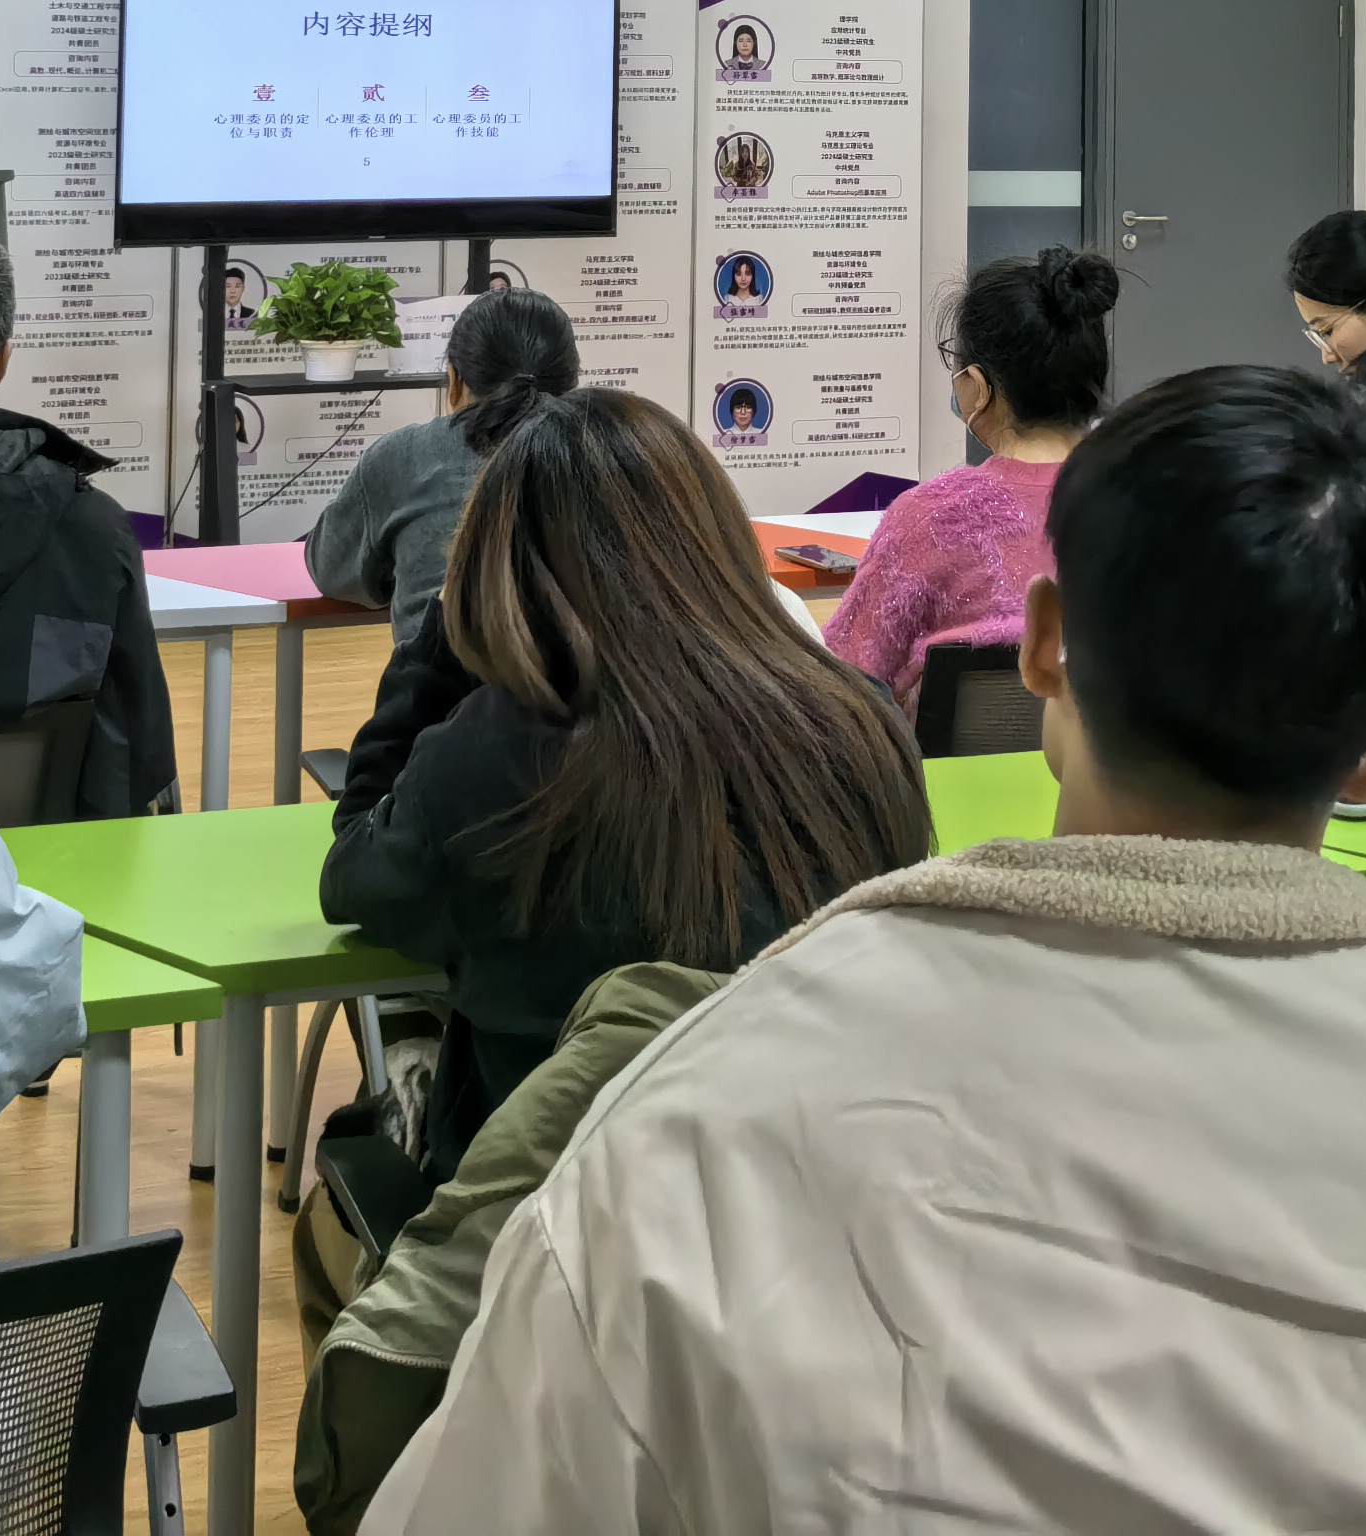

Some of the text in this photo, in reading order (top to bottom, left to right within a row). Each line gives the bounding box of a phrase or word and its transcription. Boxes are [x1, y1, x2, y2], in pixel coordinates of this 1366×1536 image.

[303, 11, 433, 38] 内容提纲
[252, 83, 491, 103] 壹 贰 叁
[214, 113, 310, 125] 心理委员的定
[325, 113, 418, 125] 心理委员的工
[433, 113, 522, 125] 心理委员的工
[38, 128, 117, 136] 测绘与城市空间信息学
[230, 126, 293, 139] 位与职责
[349, 126, 395, 138] 作伦理
[455, 126, 500, 138] 作技能
[363, 157, 371, 167] 5
